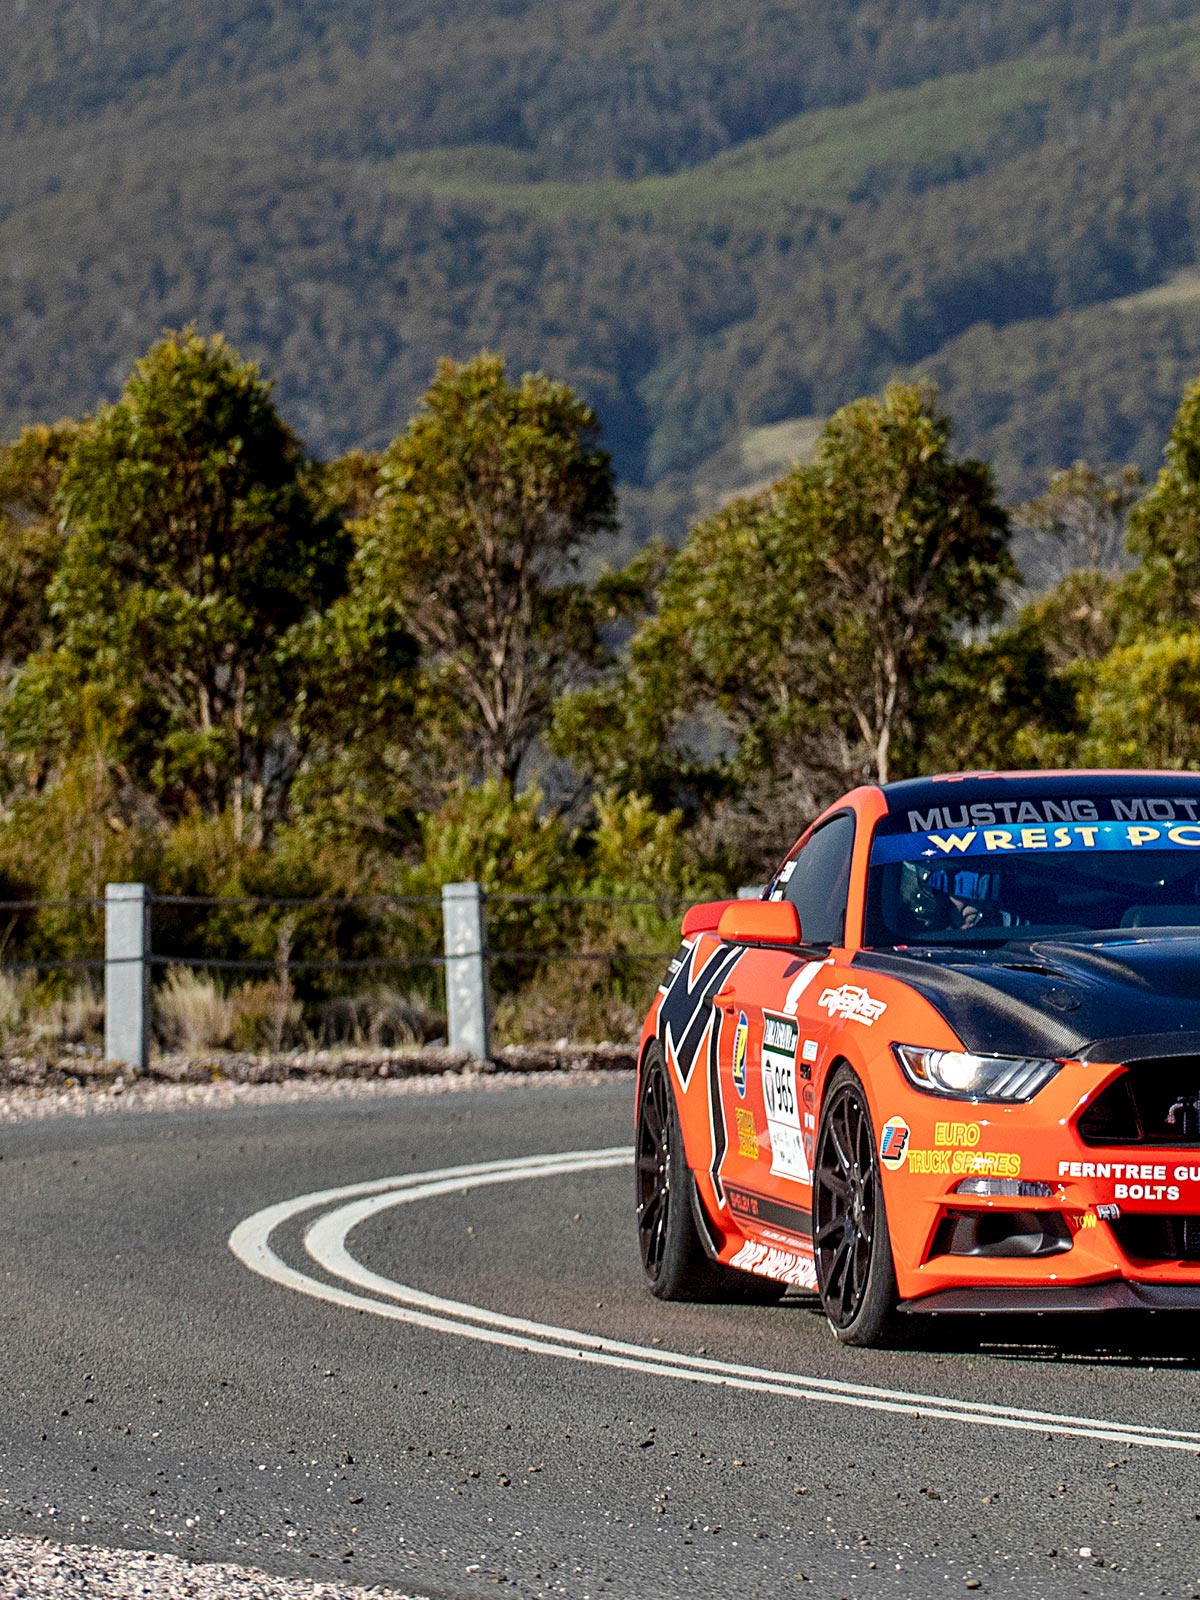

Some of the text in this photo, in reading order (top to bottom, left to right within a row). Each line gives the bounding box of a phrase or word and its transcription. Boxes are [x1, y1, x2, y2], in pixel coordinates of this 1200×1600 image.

[908, 800, 1098, 832] MUSTANG
[927, 827, 1098, 853] WREST
[775, 1066, 794, 1115] 965
[934, 1122, 980, 1147] EURO
[907, 1150, 1021, 1177] TRUCK SPARES
[1058, 1161, 1167, 1180] FERNTREE
[1114, 1184, 1180, 1200] BOLTS
[1073, 1214, 1097, 1229] TOW
